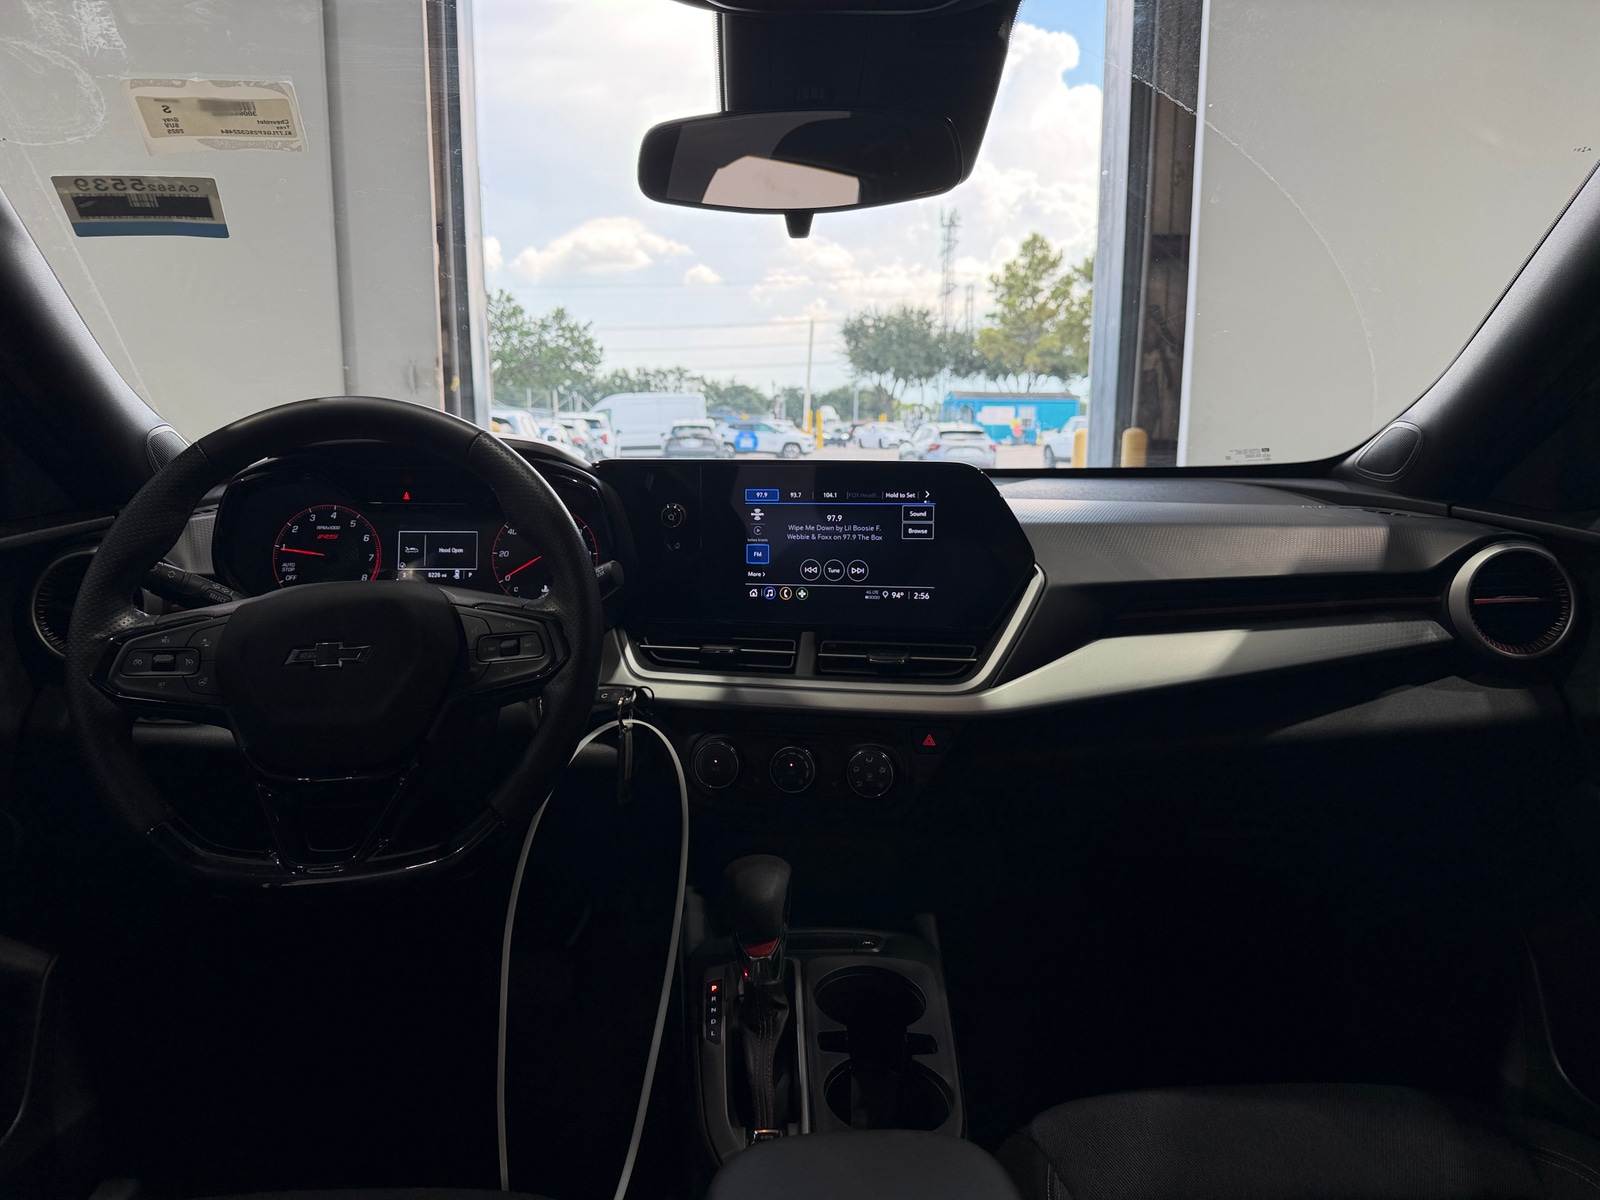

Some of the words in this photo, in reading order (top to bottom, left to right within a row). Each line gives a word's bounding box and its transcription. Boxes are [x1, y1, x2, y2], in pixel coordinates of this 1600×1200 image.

[826, 514, 843, 522] 97.9
[350, 520, 357, 528] 5
[291, 525, 299, 533] 2
[788, 525, 804, 533] Wipe
[835, 525, 843, 533] by
[908, 527, 928, 535] Browse
[363, 534, 370, 542] 6
[913, 592, 930, 600] 2:56
